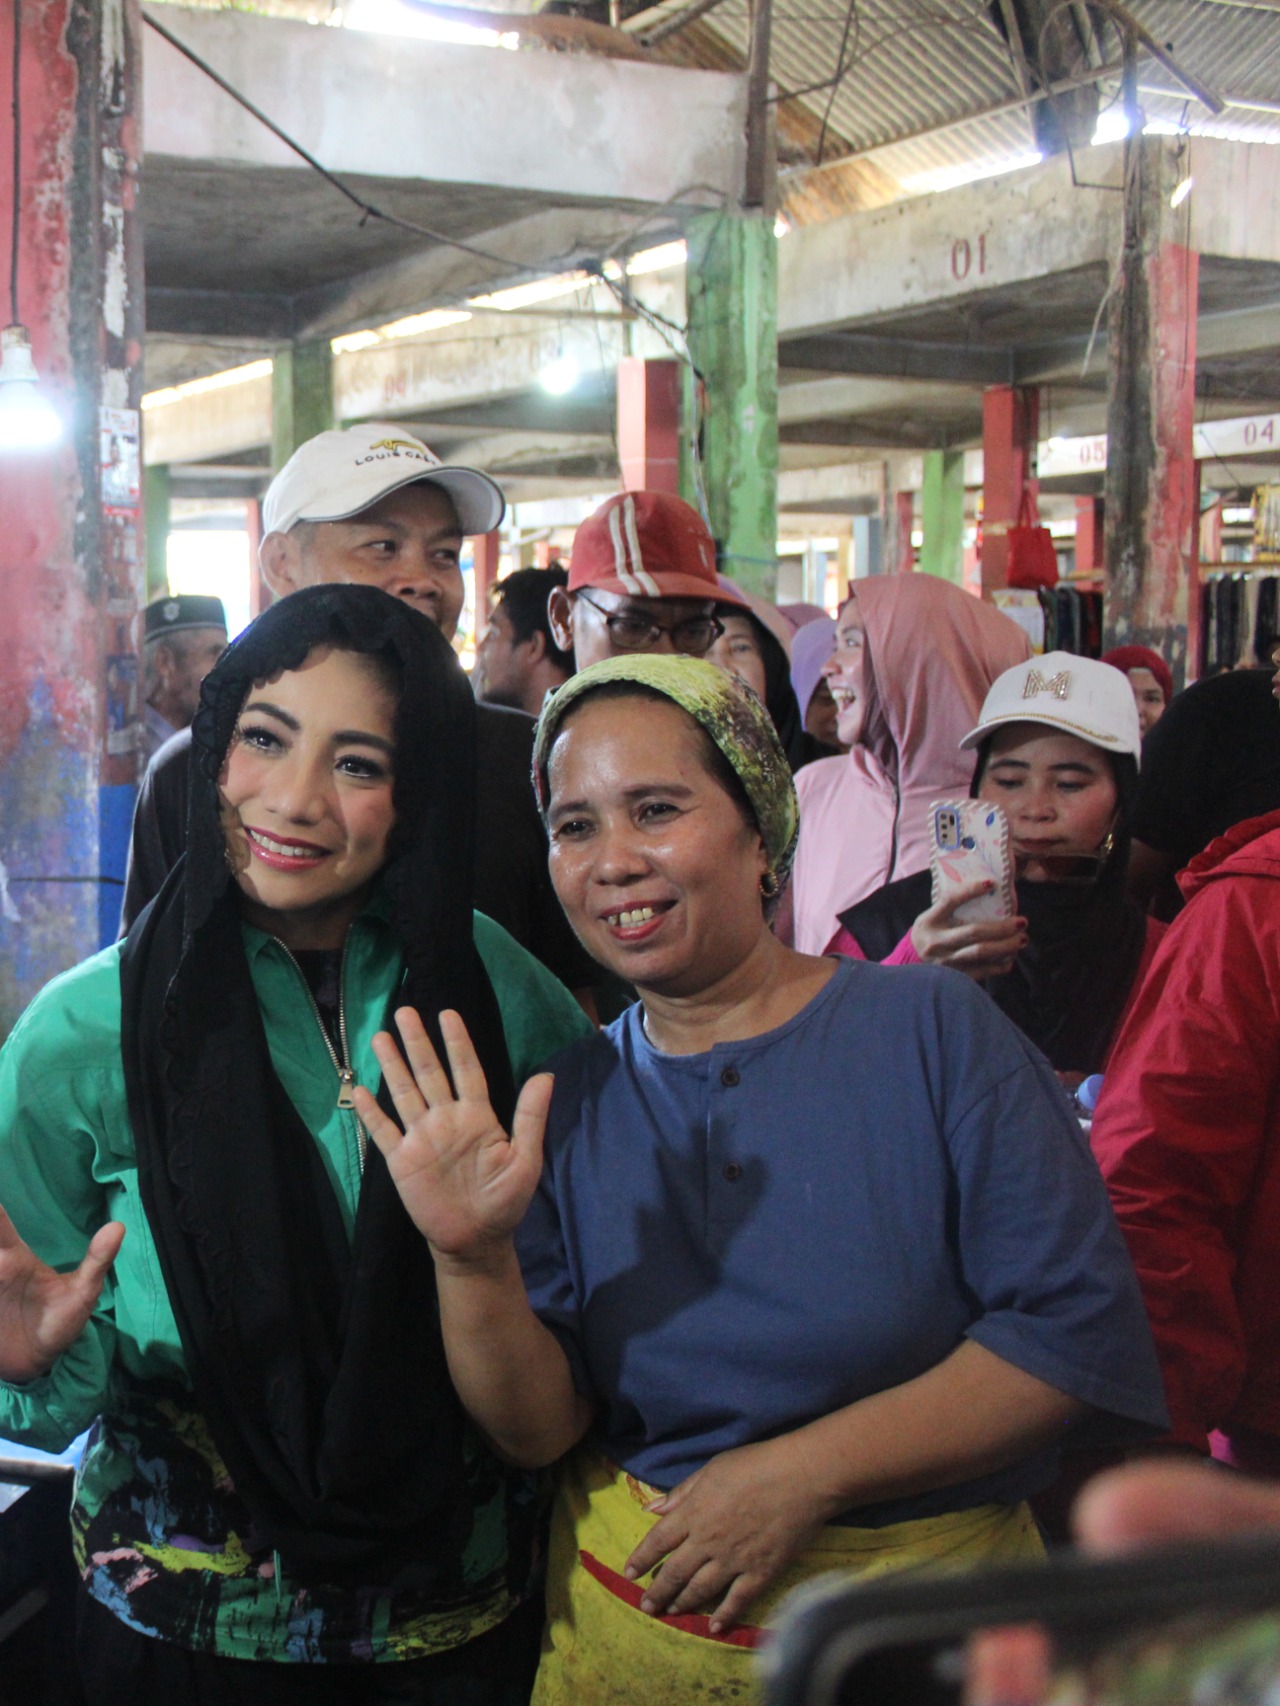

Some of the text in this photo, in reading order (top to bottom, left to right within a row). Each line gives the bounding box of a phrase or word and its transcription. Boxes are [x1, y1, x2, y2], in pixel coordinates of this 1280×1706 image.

[951, 233, 987, 281] 01
[1244, 419, 1274, 446] 04
[1022, 668, 1071, 701] M
